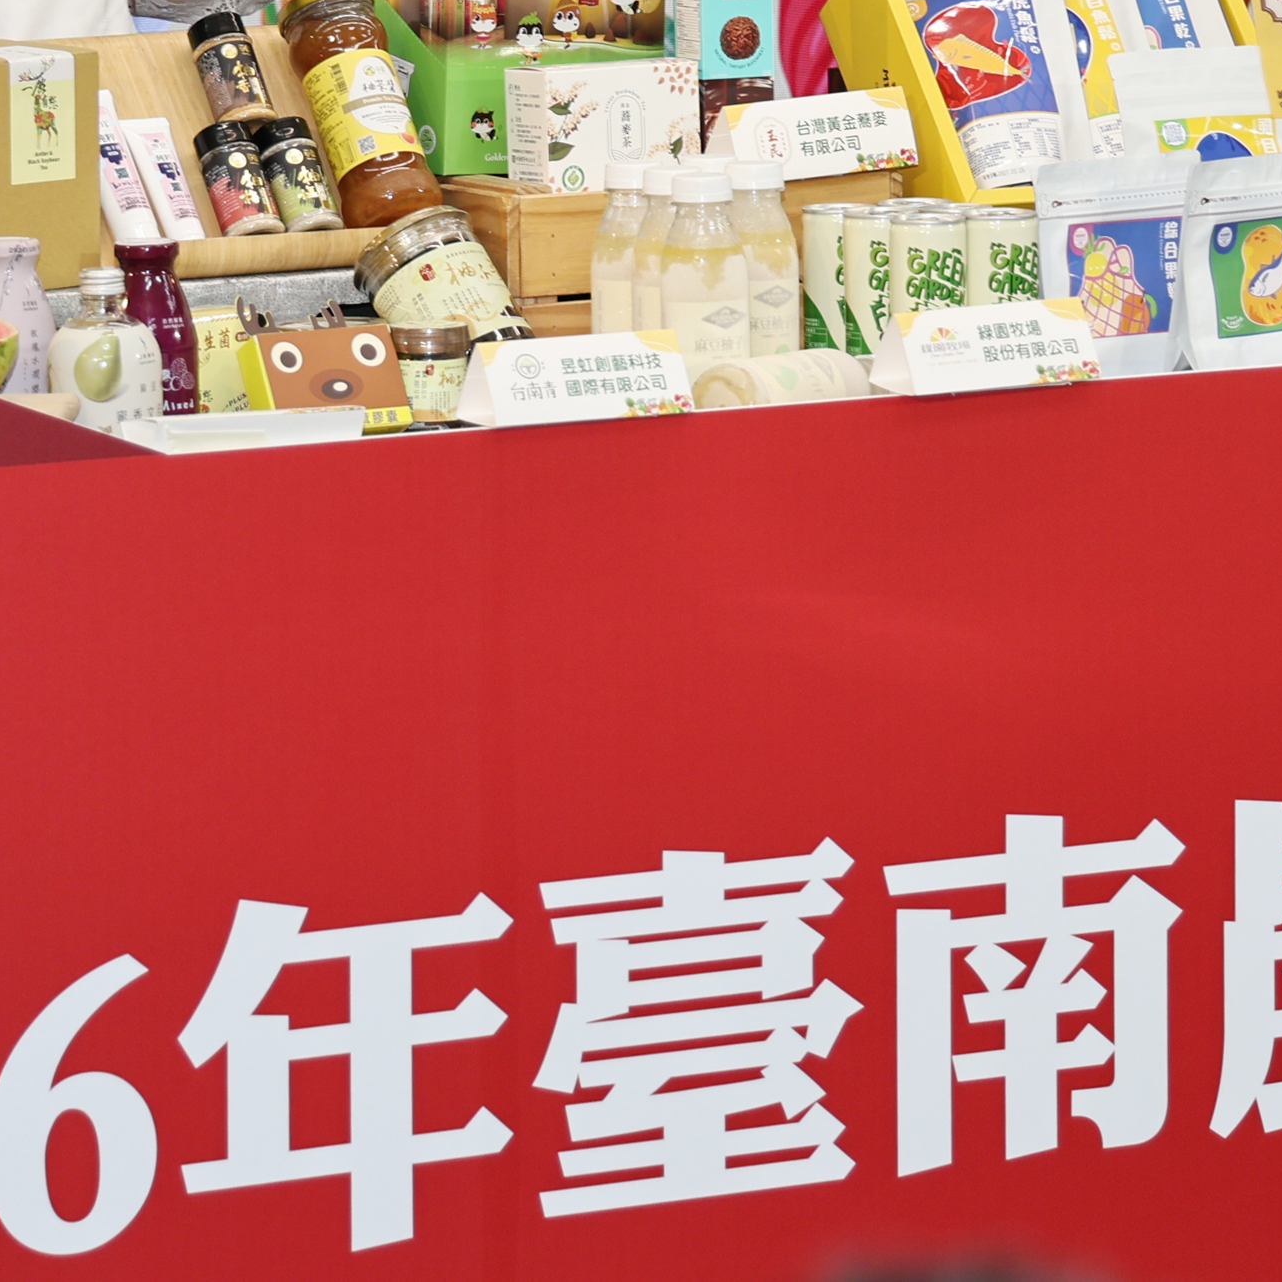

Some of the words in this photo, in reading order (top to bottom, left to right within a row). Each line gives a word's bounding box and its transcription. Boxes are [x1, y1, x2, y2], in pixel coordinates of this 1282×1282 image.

[795, 111, 888, 136] 台灣黃金蕎麥
[800, 134, 862, 158] 有限公司
[976, 319, 1043, 341] 綠園牧場
[983, 338, 1080, 363] 股份有限公司
[560, 352, 664, 375] 昱虹創藝科技
[510, 380, 558, 402] 台南青
[565, 374, 668, 397] 國際有限公司
